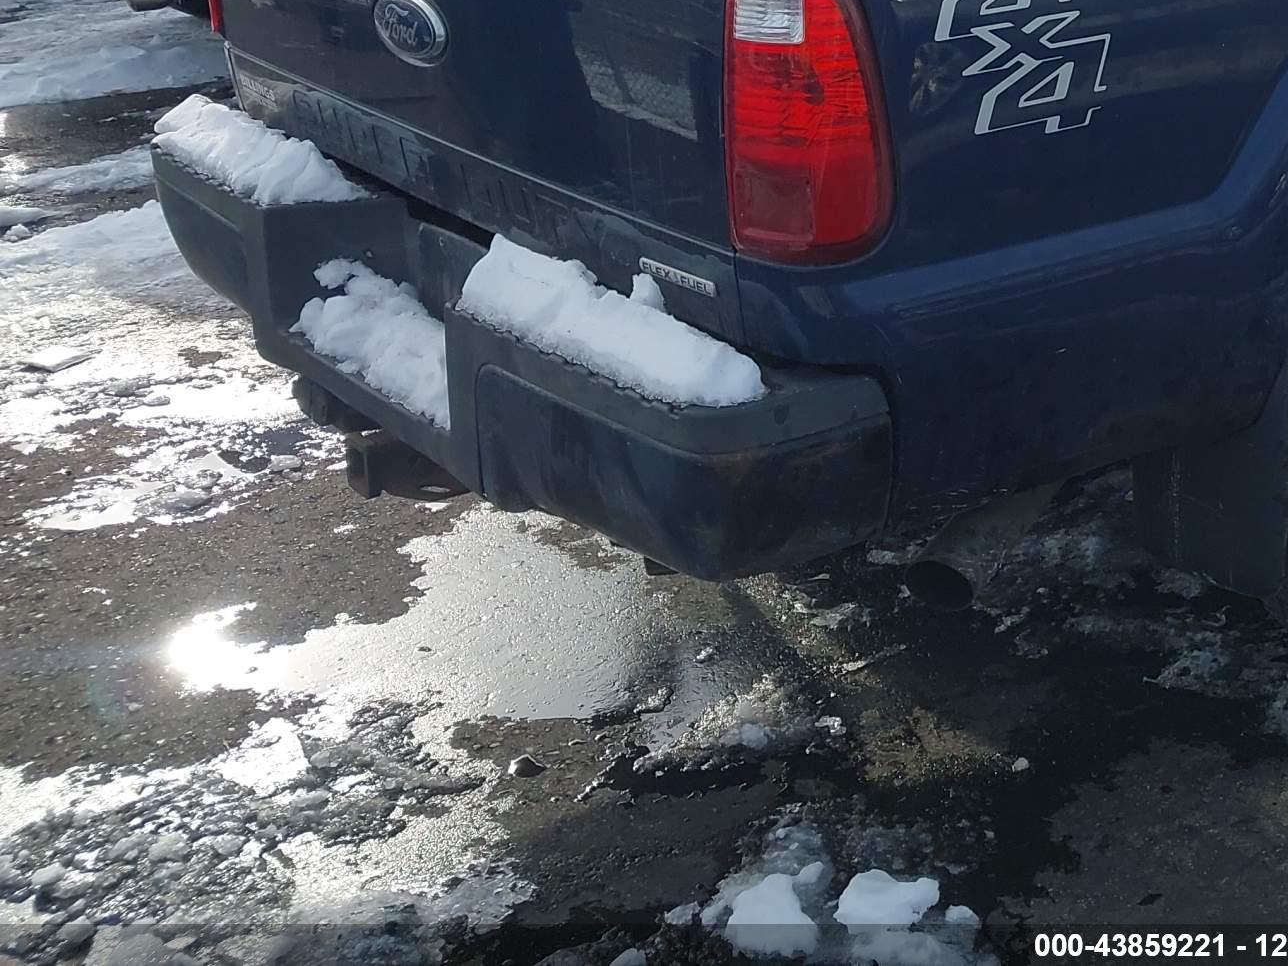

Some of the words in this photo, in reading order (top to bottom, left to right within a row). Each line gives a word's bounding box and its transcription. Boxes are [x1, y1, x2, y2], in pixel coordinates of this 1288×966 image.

[382, 3, 419, 46] Ford
[642, 262, 671, 279] FLEX
[680, 276, 712, 295] FUEL
